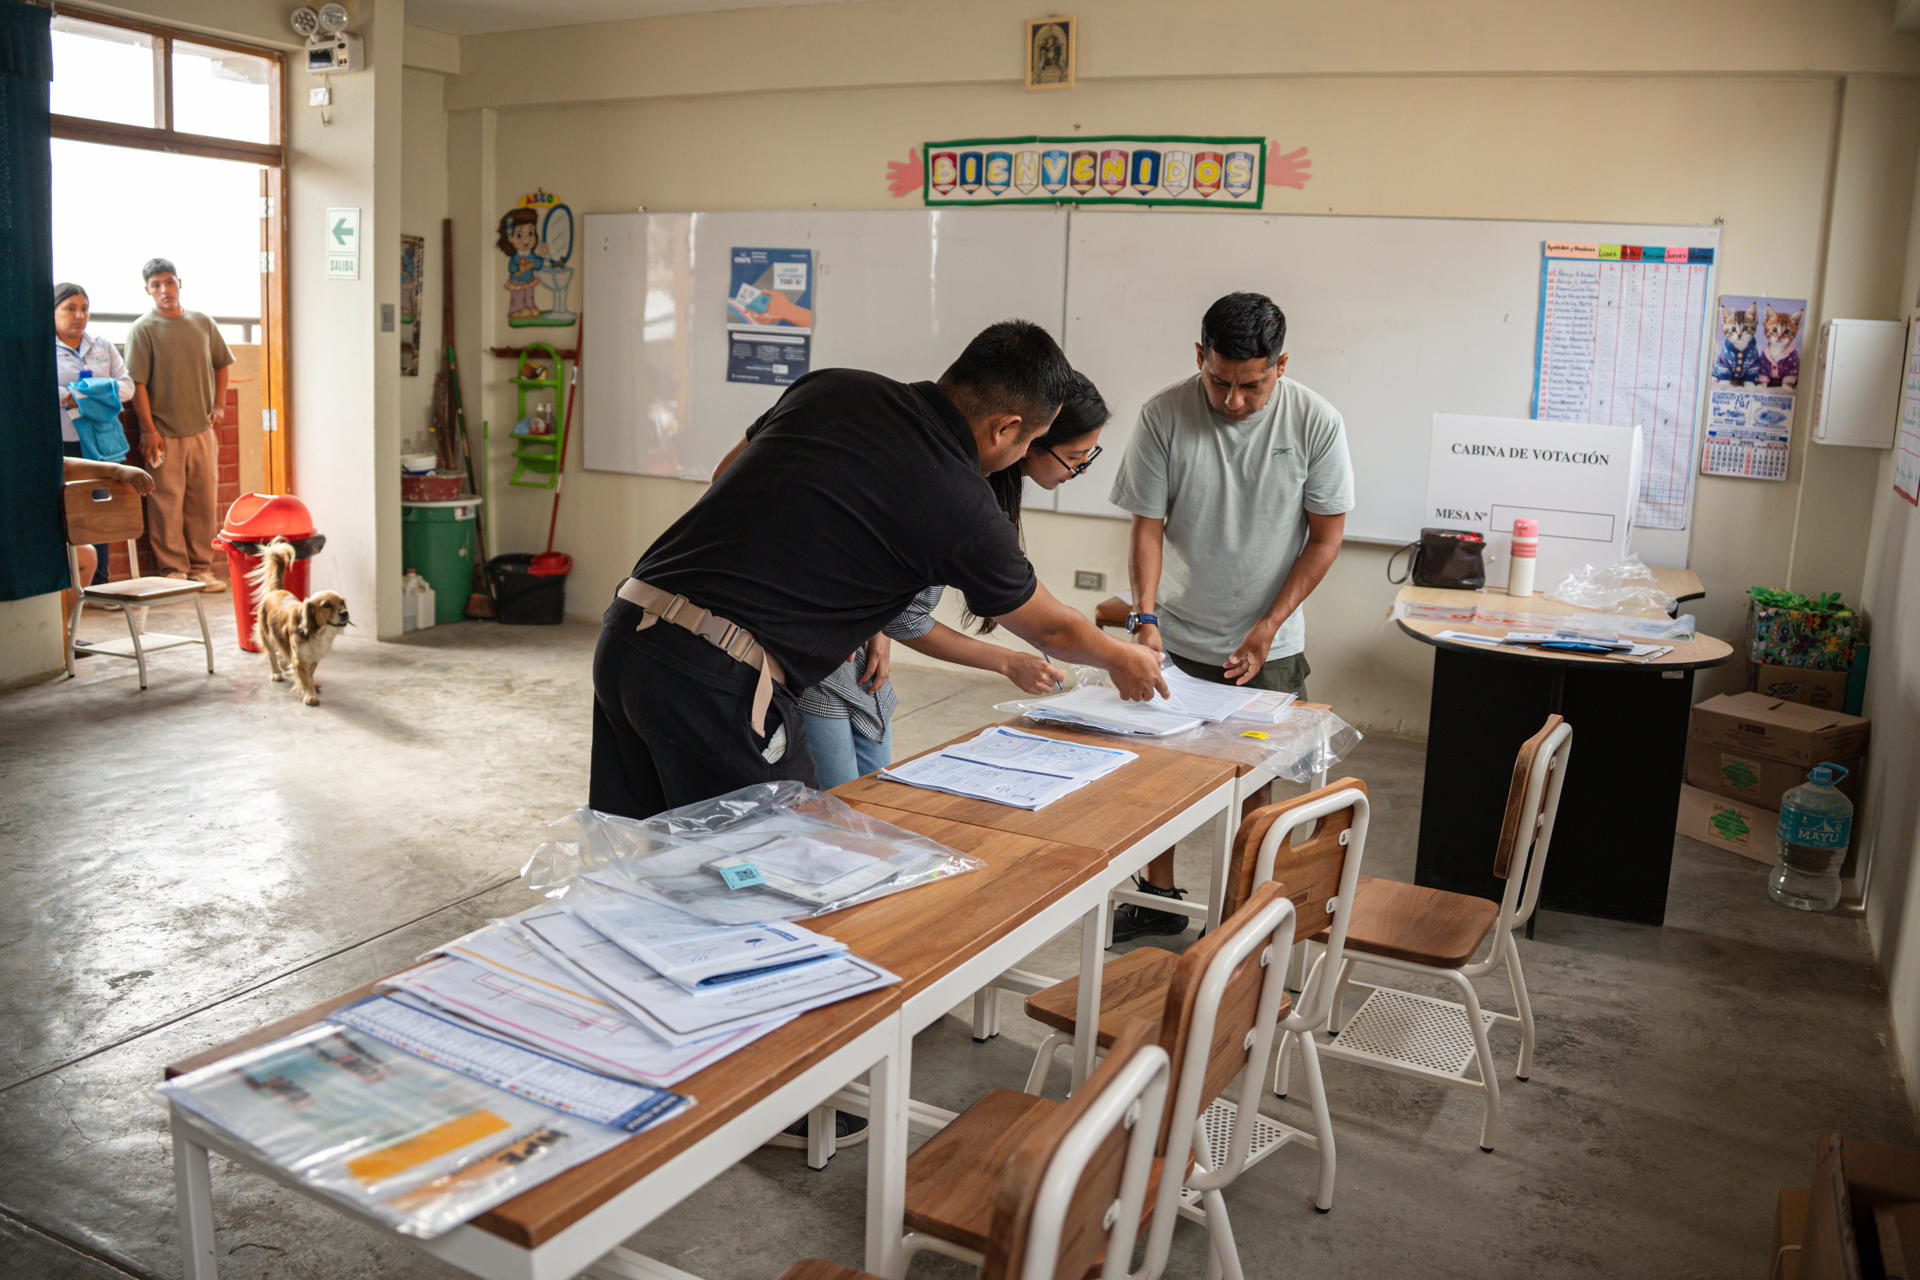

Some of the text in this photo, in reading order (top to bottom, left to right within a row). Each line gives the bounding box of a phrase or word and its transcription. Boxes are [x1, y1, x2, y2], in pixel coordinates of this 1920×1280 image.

[934, 155, 1252, 184] BIENVENIDOS
[525, 192, 554, 205] ASEO
[330, 259, 354, 271] SALIDA
[1451, 442, 1611, 466] CABINA DE VOTACIÓN
[1435, 508, 1471, 520] MESA
[1798, 828, 1840, 843] MAYU
